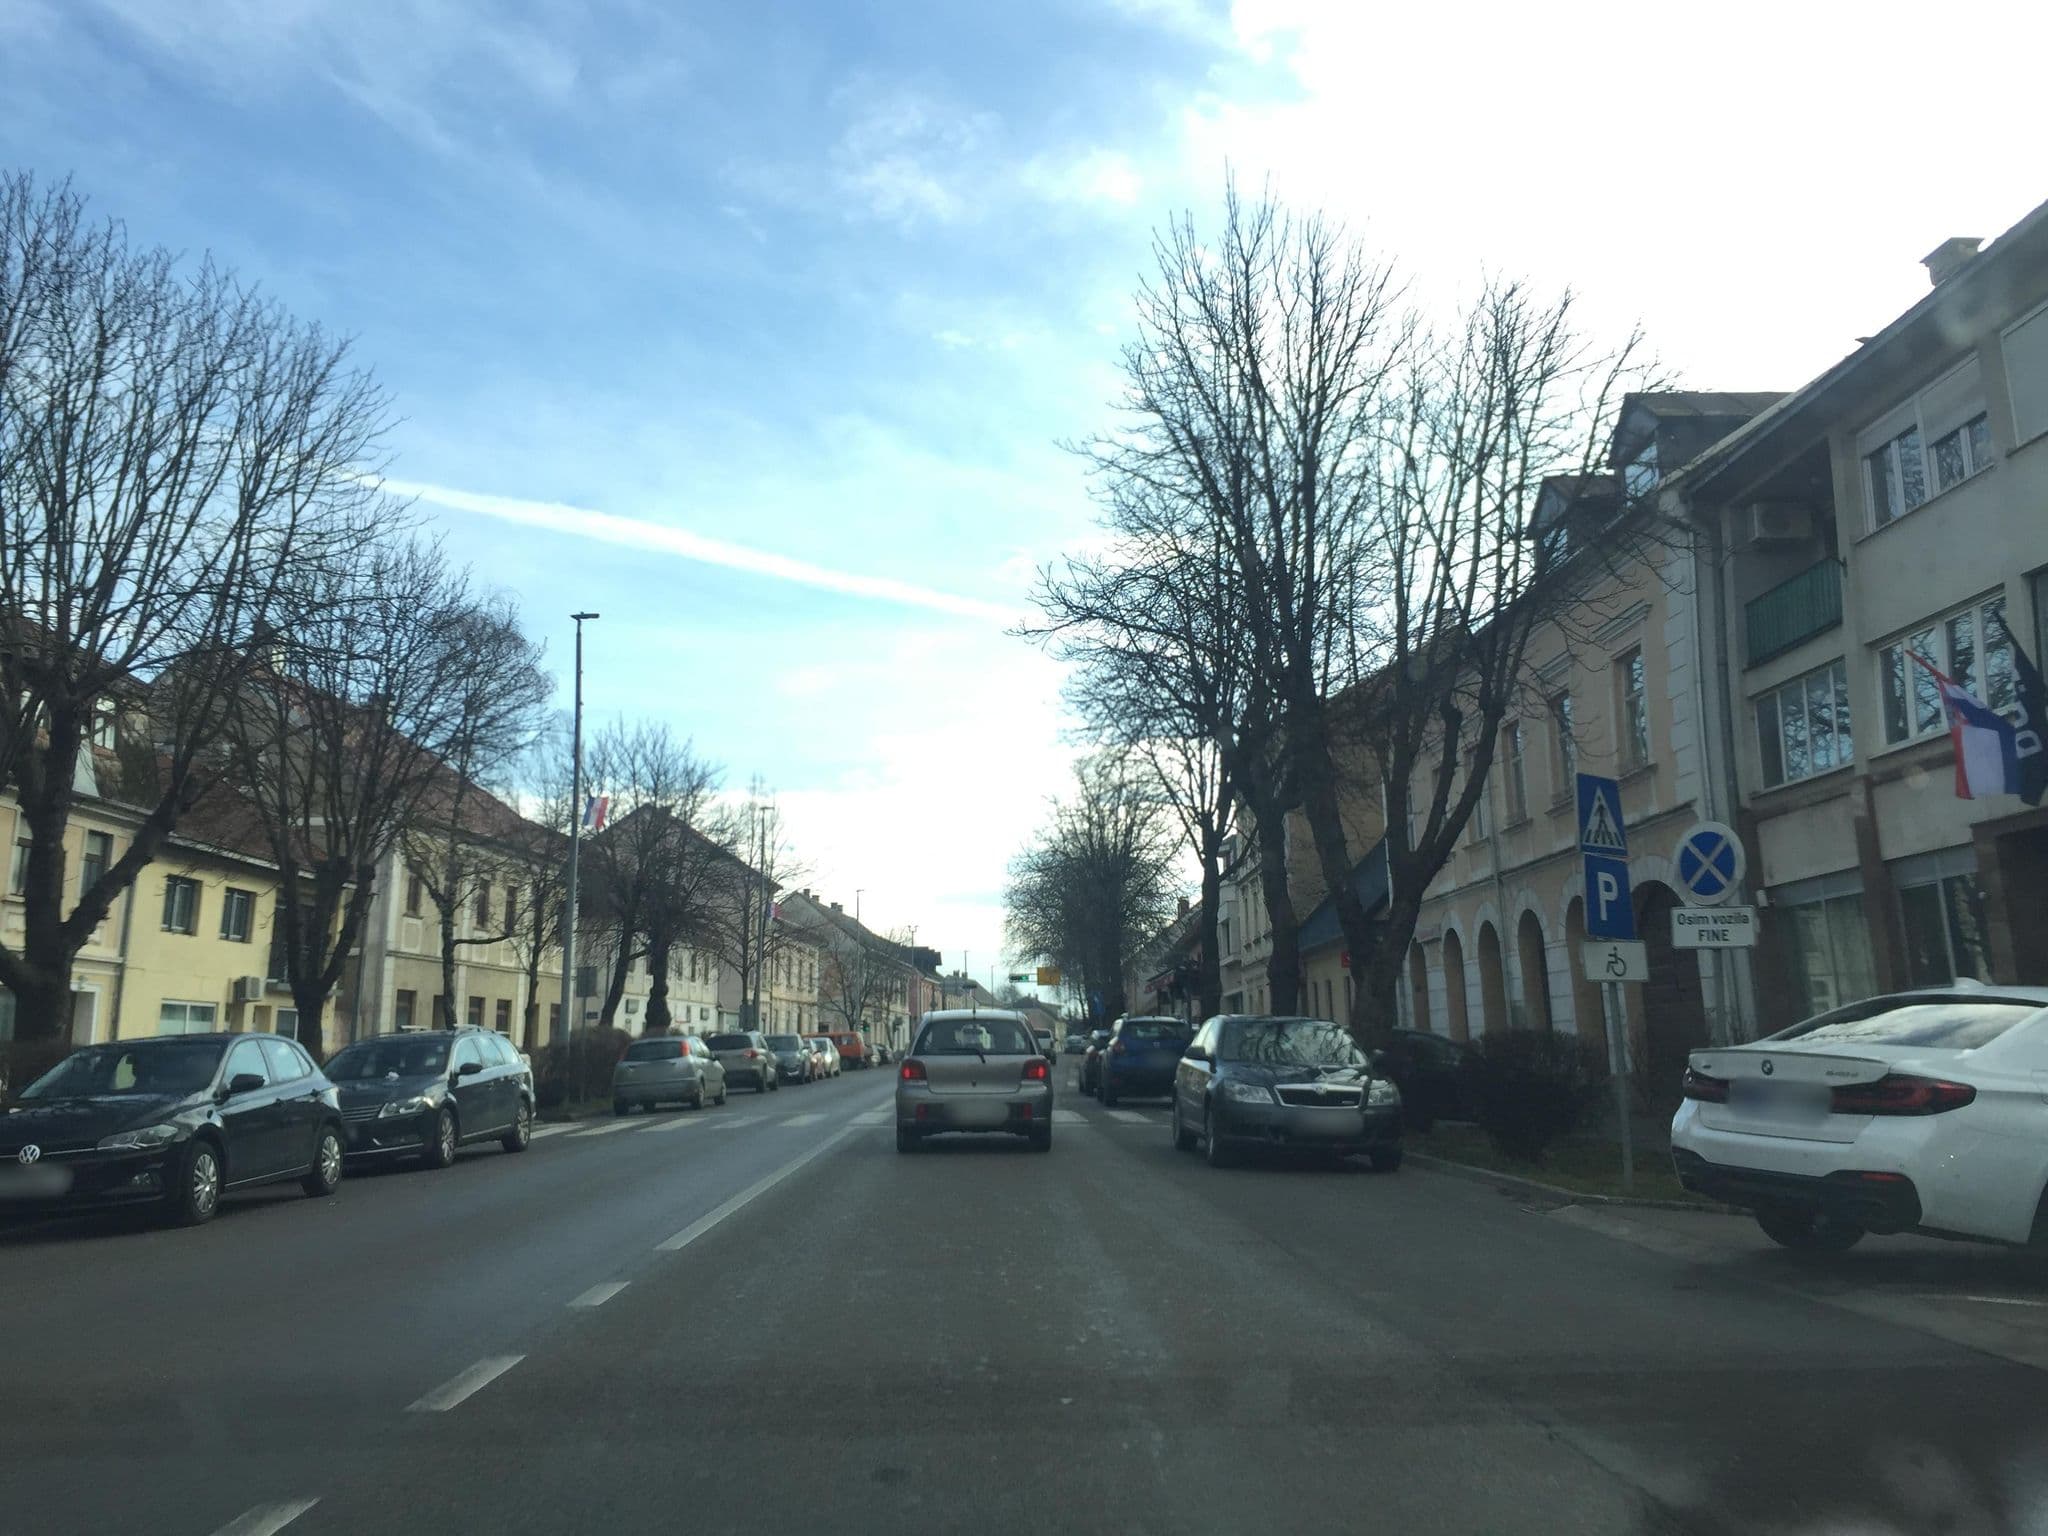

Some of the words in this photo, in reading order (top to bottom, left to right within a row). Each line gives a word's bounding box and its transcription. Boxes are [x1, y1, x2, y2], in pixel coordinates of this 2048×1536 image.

[1597, 872, 1619, 921] P
[1677, 913, 1709, 925] Osim
[1711, 911, 1750, 924] vozila
[1698, 929, 1730, 941] FINE
